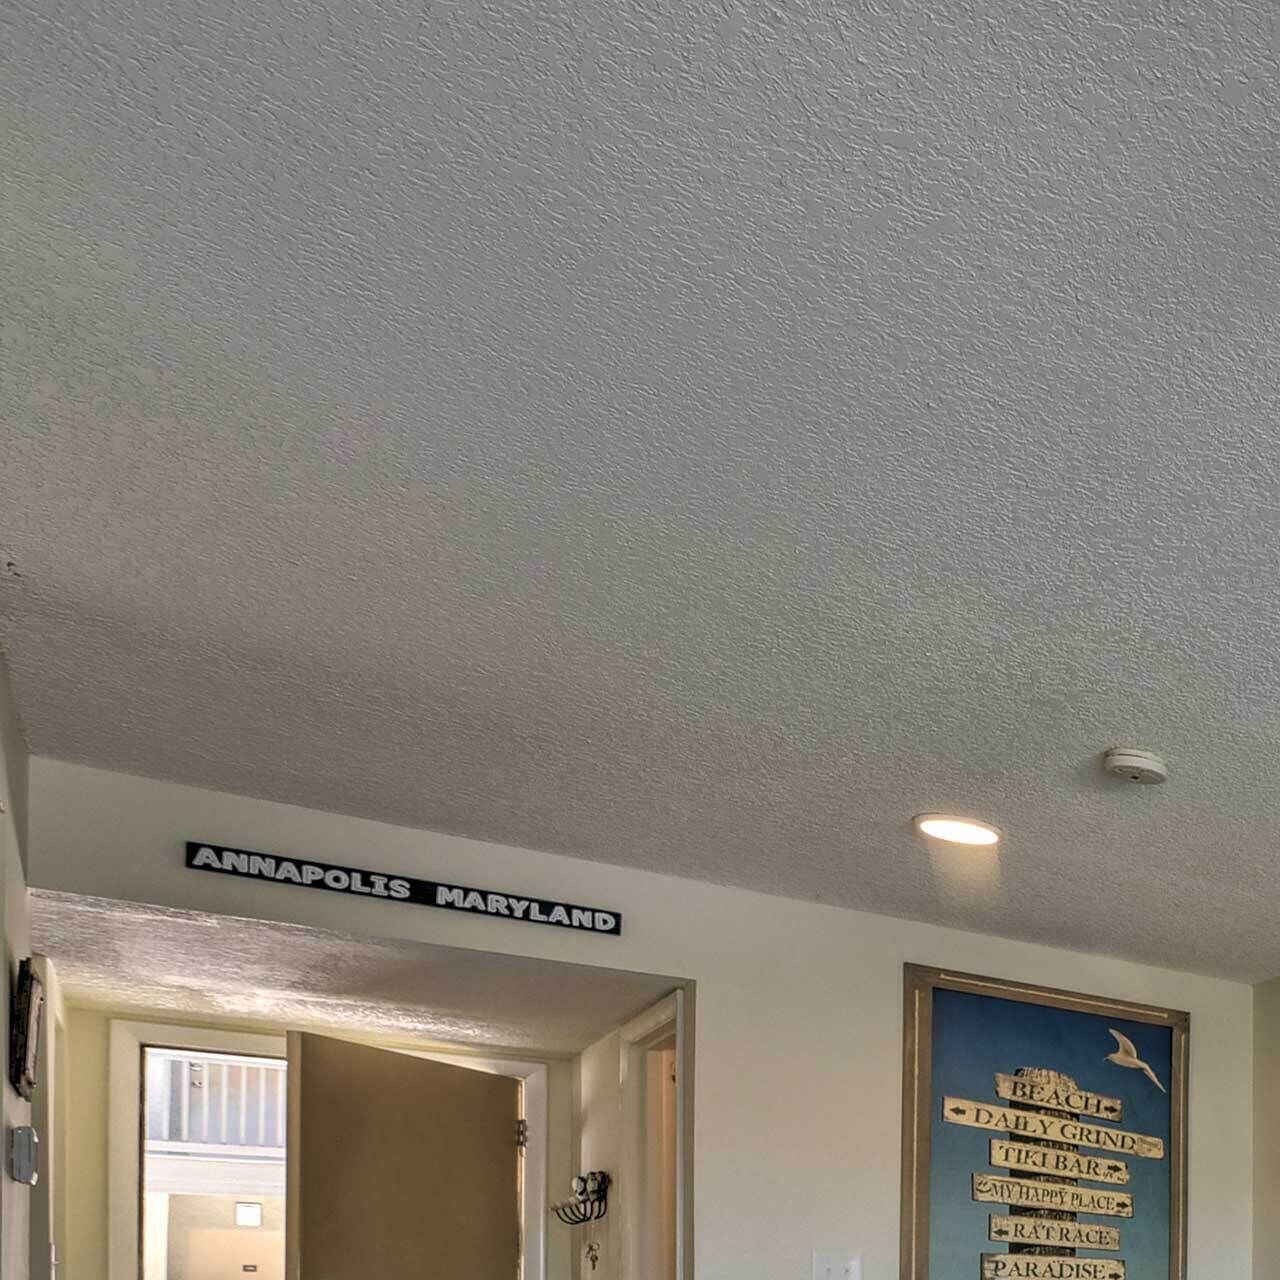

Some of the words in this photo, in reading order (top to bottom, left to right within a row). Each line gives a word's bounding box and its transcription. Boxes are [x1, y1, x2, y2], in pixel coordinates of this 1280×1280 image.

[193, 846, 411, 899] ANNAPOLIS
[436, 885, 616, 931] MARYLAND
[1011, 1081, 1102, 1114] BEACH
[974, 1108, 1054, 1135] DAILY
[1060, 1123, 1137, 1151] GRIND
[1000, 1145, 1049, 1168] TIKI
[1055, 1154, 1101, 1177] BAR
[990, 1182, 1016, 1200] MY
[1018, 1183, 1068, 1206] HAPPY
[1071, 1192, 1116, 1211] PLACE
[1013, 1223, 1056, 1241] RAT
[1059, 1227, 1111, 1246] RACE
[993, 1259, 1106, 1280] PARADISE
